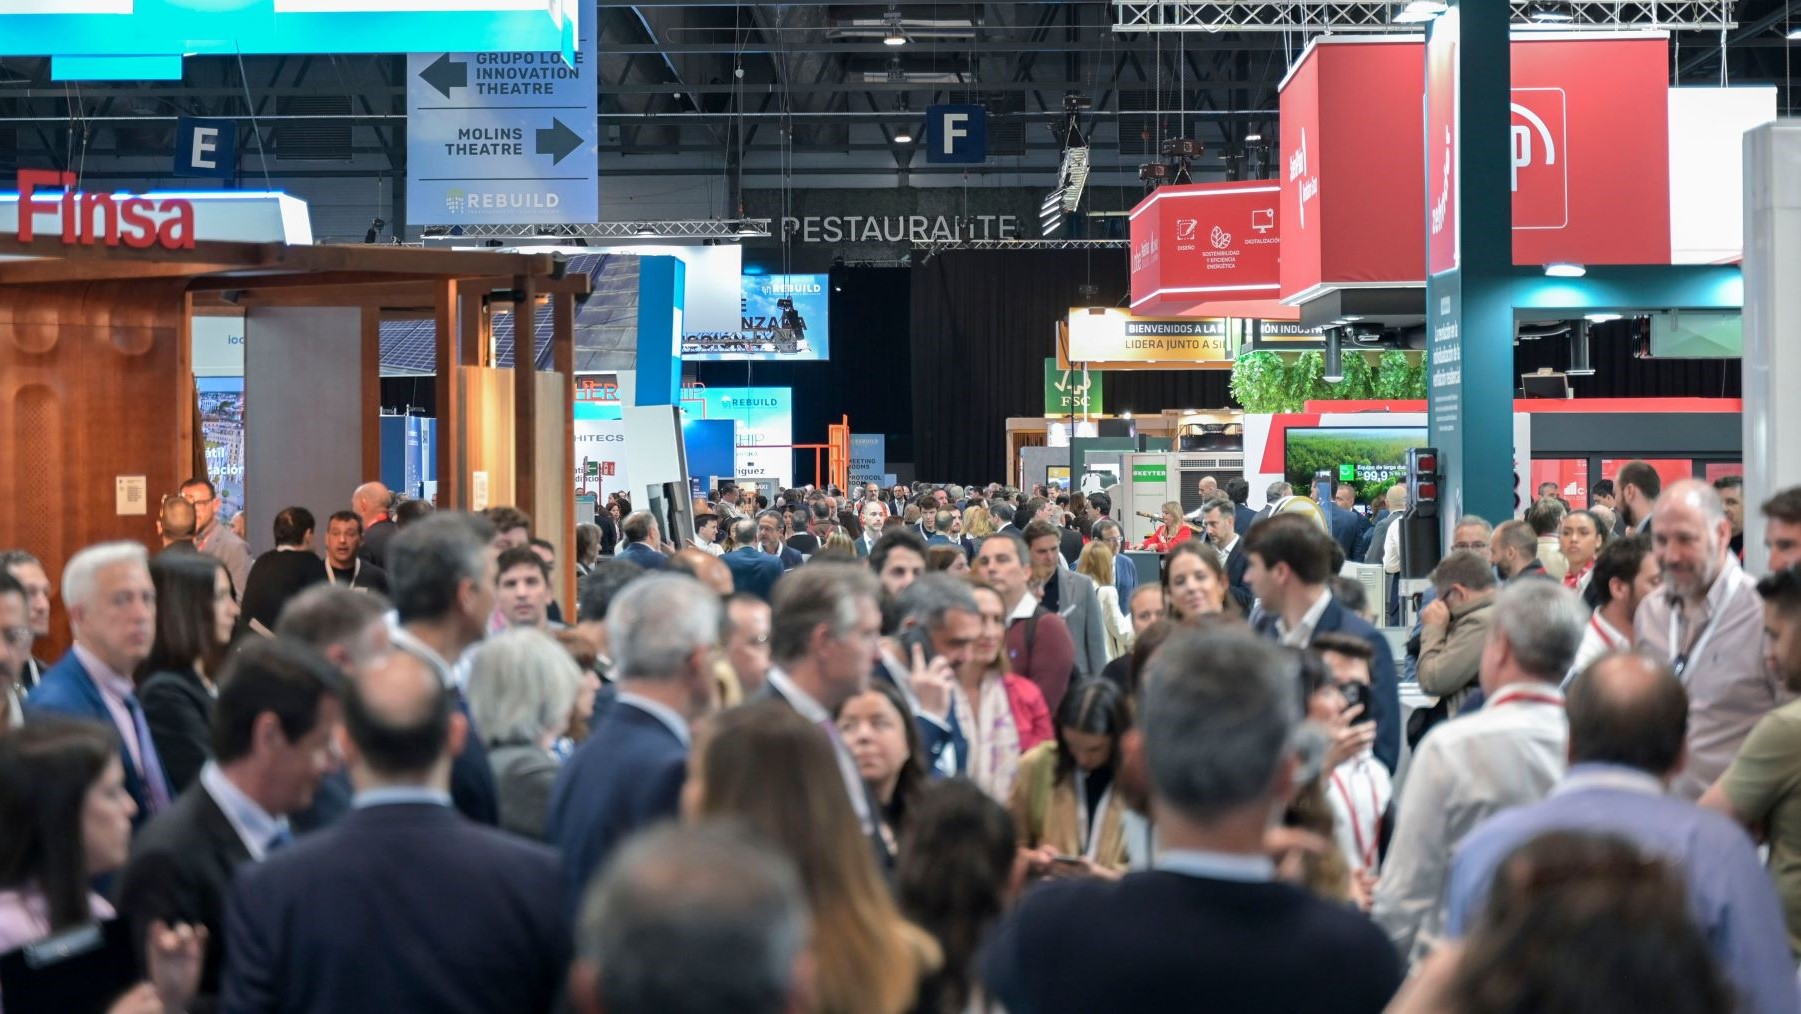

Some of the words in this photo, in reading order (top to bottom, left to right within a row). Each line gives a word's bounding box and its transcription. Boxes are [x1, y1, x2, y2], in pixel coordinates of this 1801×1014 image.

[476, 52, 535, 65] GRUPO
[540, 52, 584, 65] LOE
[476, 67, 579, 80] INNOVATION
[476, 82, 554, 95] THEATRE
[458, 128, 523, 140] MOLINS
[943, 113, 969, 154] F
[191, 127, 219, 168] E
[445, 143, 523, 156] THEATRE
[467, 193, 560, 208] REBUILD
[16, 168, 196, 250] Finsa
[773, 284, 821, 293] REBUILD
[1128, 324, 1193, 334] BIENVENIDOS
[1194, 324, 1202, 334] A
[1203, 324, 1217, 334] LA
[1125, 339, 1164, 349] LIDERA
[1166, 339, 1200, 350] JUNTO
[1202, 340, 1210, 349] A
[732, 398, 778, 407] REBUILD
[1061, 396, 1091, 407] FSC
